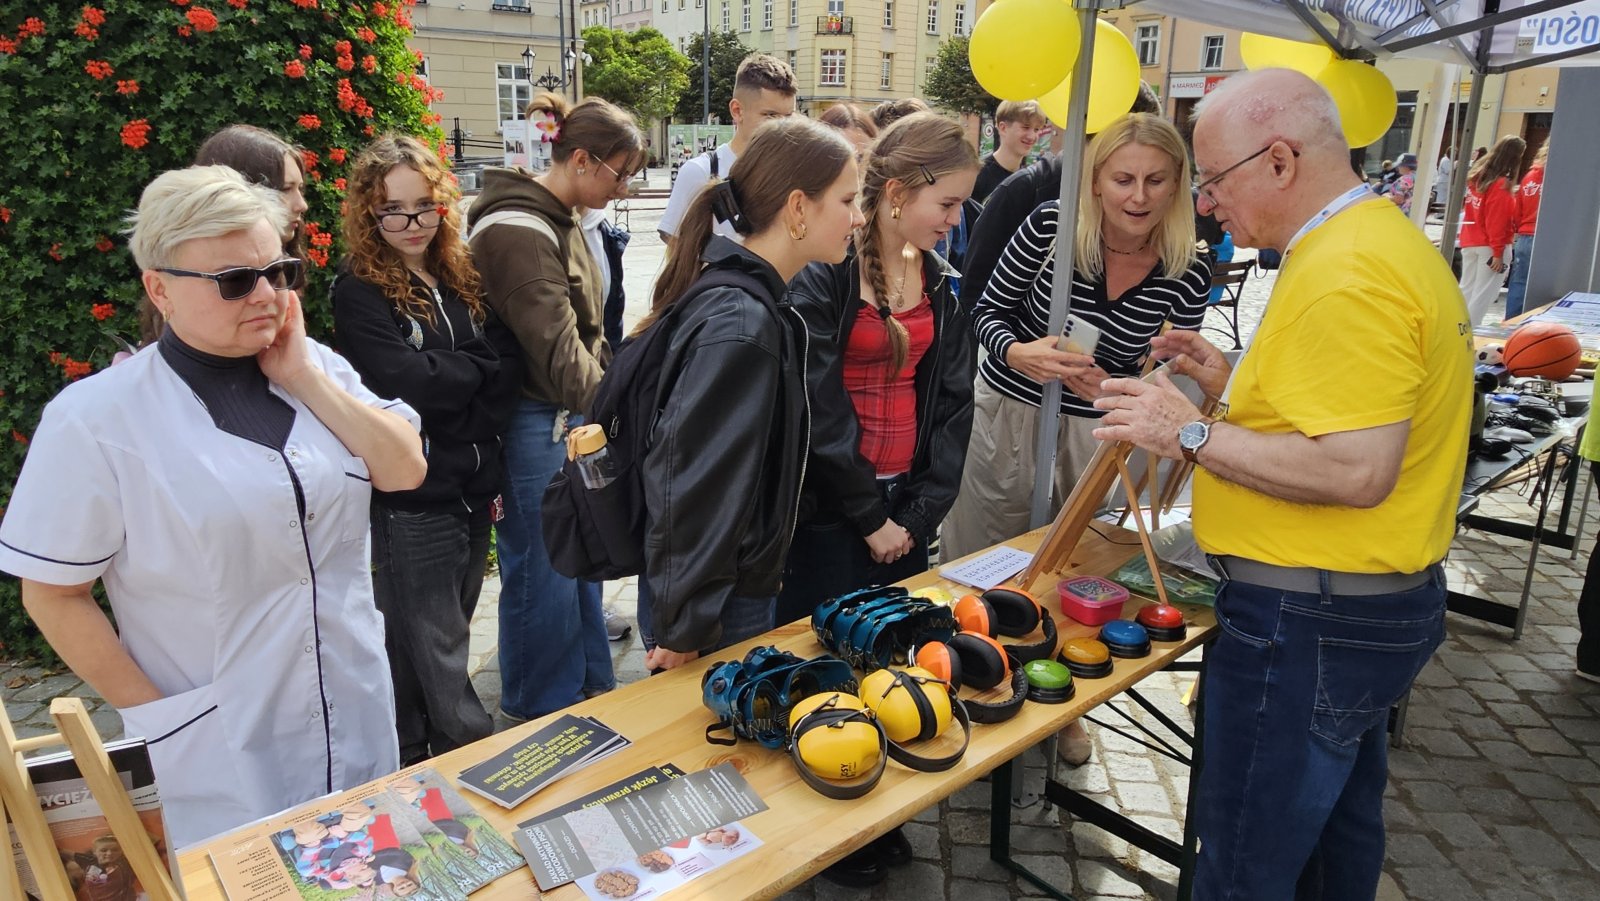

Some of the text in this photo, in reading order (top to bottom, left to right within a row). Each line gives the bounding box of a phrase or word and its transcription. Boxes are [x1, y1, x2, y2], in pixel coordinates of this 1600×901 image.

[631, 774, 659, 792] Język
[542, 841, 568, 881] ZAWODOWEJ
[544, 861, 560, 883] ZAKŁAD
